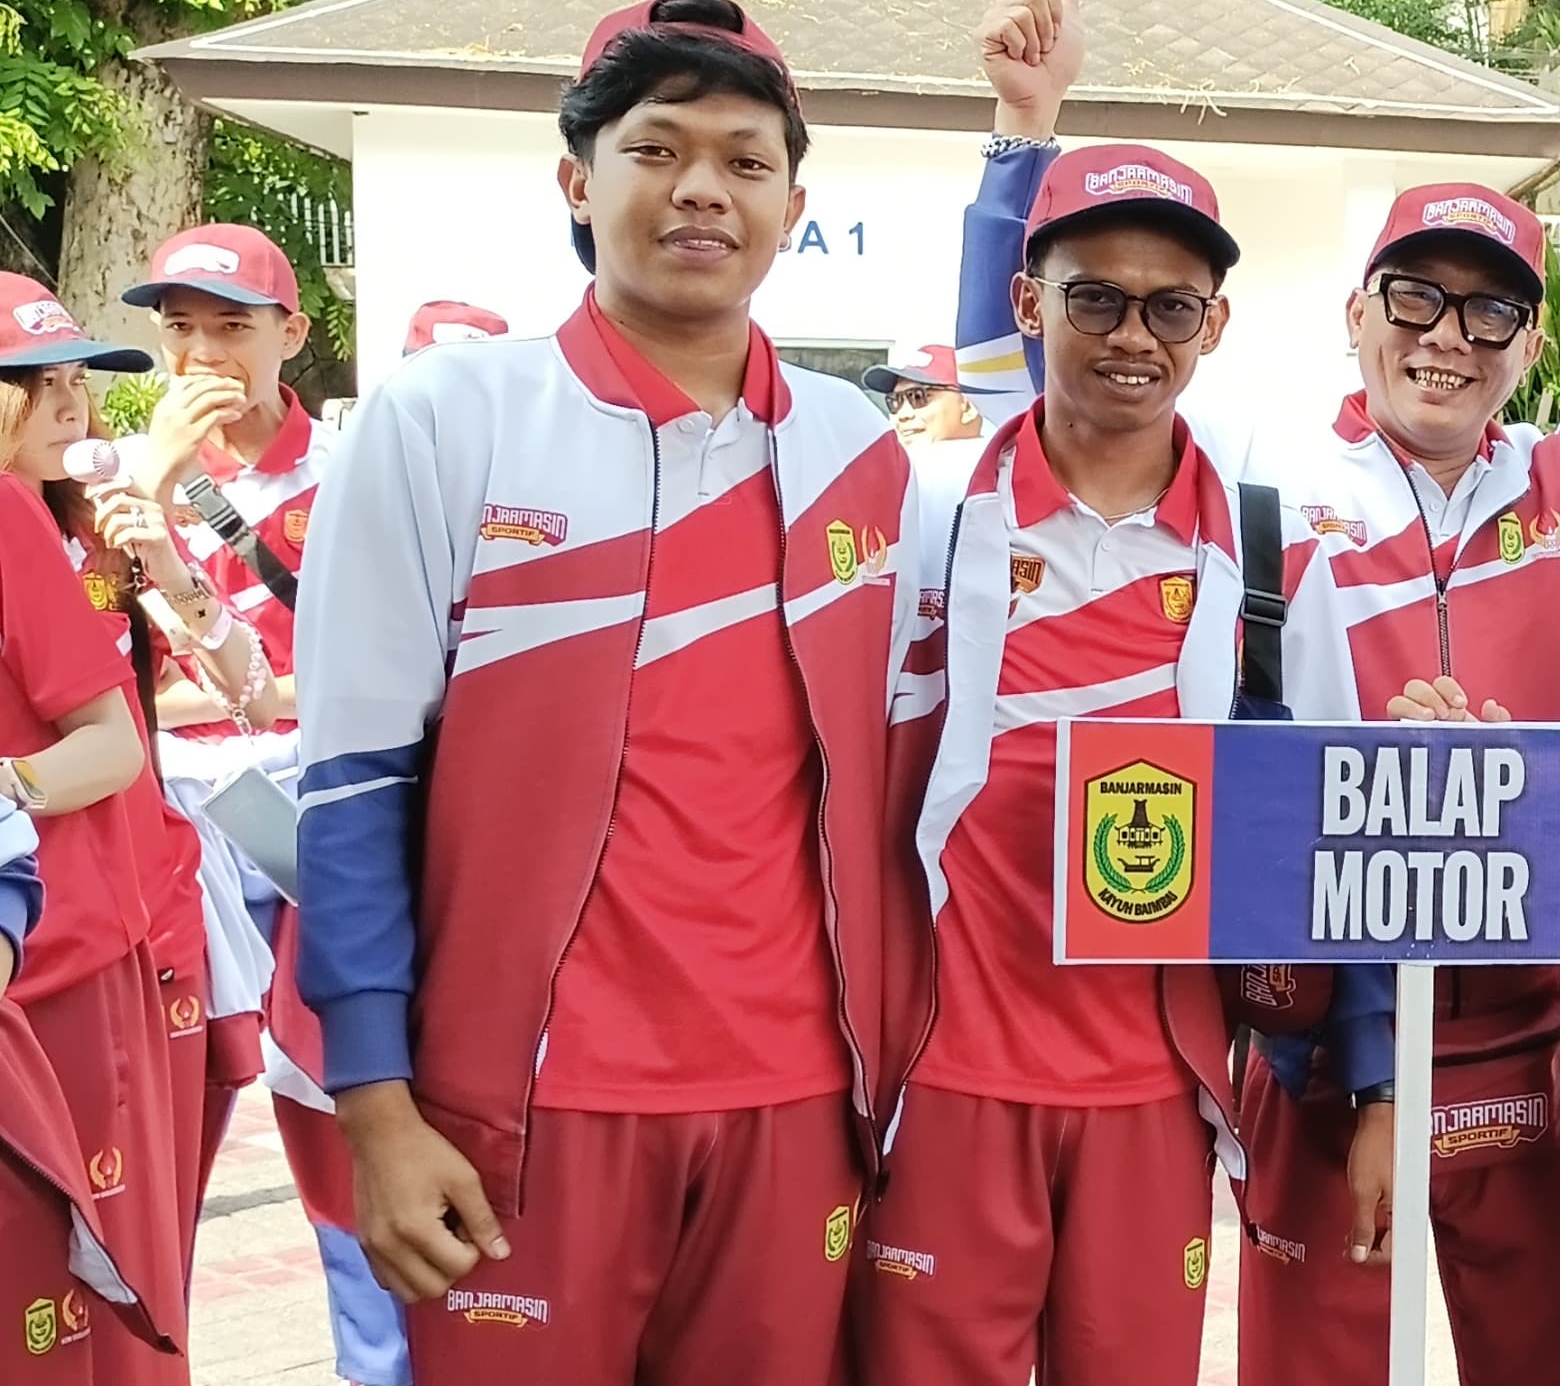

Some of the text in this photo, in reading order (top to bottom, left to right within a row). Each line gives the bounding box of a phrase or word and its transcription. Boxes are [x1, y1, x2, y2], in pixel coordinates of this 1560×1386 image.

[1087, 165, 1193, 207] BANJARMASIN
[482, 505, 566, 539] NJARMASIN
[1100, 781, 1182, 795] BANJARMASIN
[1323, 746, 1526, 837] BALAP
[1098, 886, 1133, 915] KAYUH
[1311, 849, 1529, 941] MOTOR
[1431, 1097, 1544, 1135] NJARMASIN
[1447, 1128, 1508, 1145] SPORTIF
[447, 1289, 548, 1323] BANJARMASIN
[473, 1309, 519, 1321] SPORTIF
